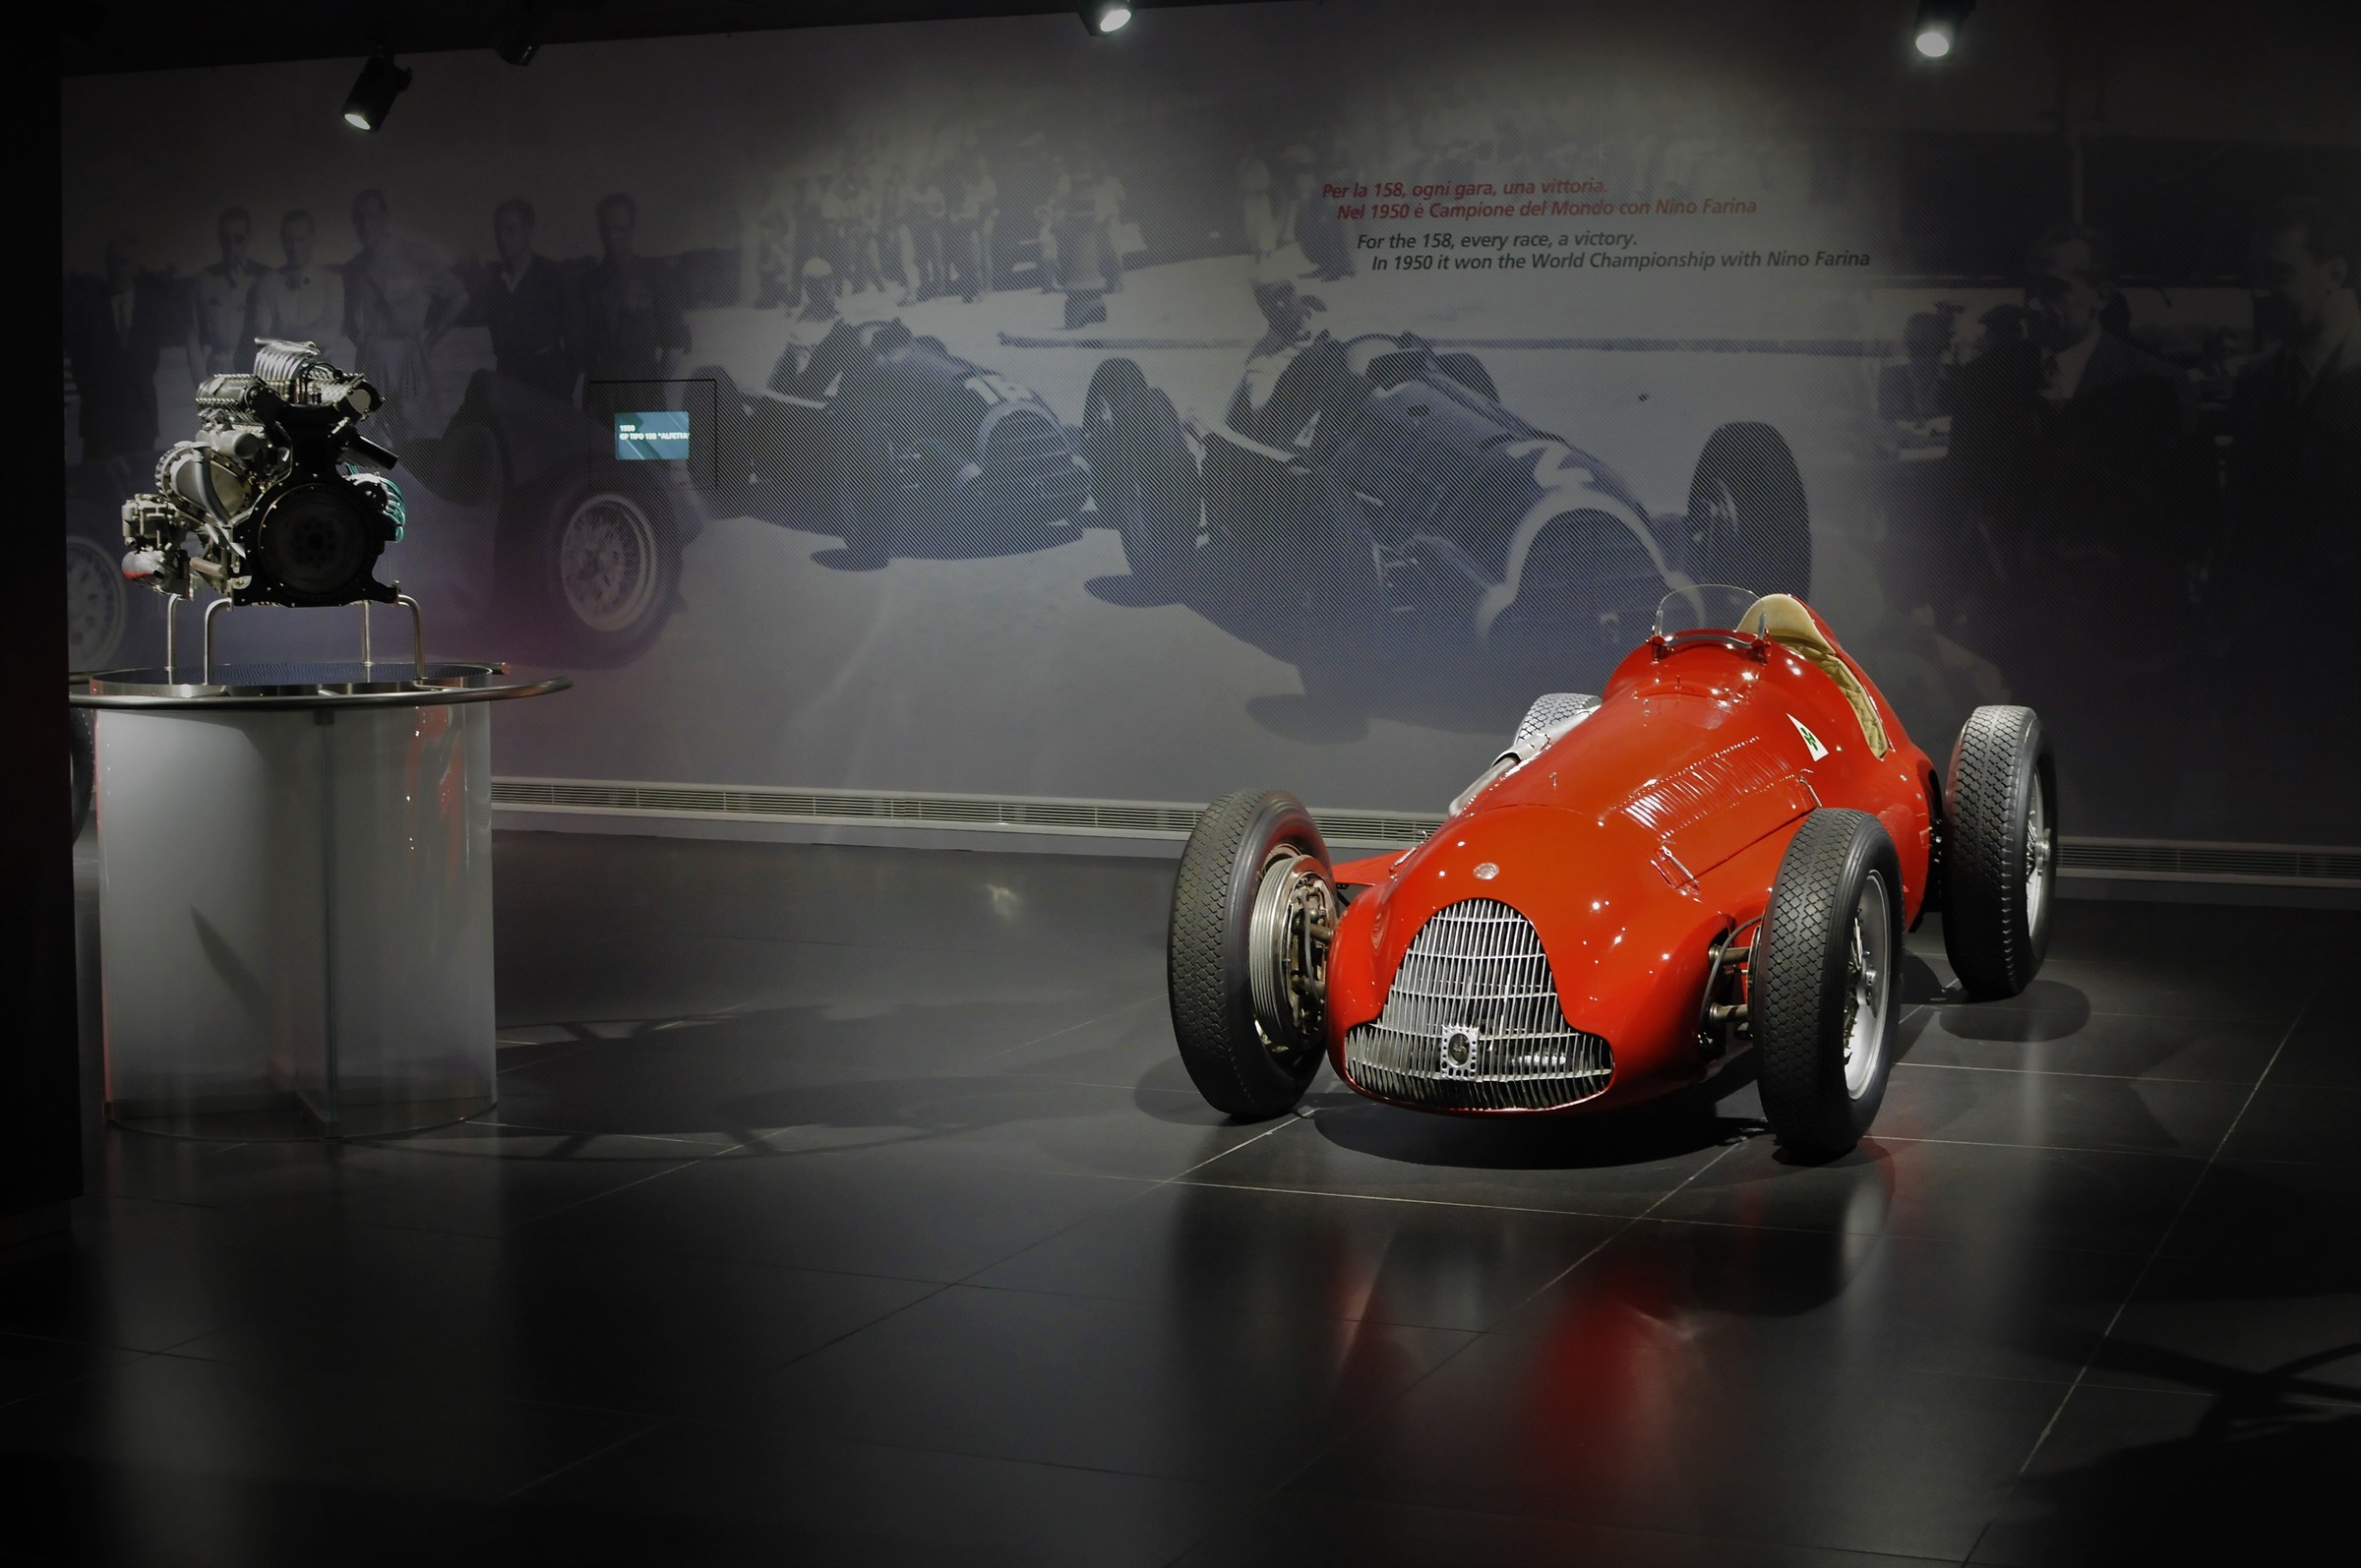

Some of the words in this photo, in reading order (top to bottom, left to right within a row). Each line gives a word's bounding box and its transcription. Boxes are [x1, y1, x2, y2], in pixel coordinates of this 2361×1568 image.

[1322, 183, 1351, 198] Per
[1353, 181, 1368, 198] la
[1373, 181, 1406, 199] 158,
[1412, 180, 1450, 201] ogni
[1454, 184, 1496, 201] gara,
[1503, 181, 1536, 195] una
[1542, 178, 1607, 195] vittoria.
[1336, 202, 1366, 220] Nel
[1371, 203, 1410, 218] 1950
[1429, 201, 1515, 222] Campione
[1519, 199, 1547, 216] del
[1551, 199, 1614, 216] Mondo
[1618, 201, 1651, 215] con
[1655, 198, 1698, 214] Nino
[1702, 197, 1758, 214] Farina
[1357, 234, 1384, 250] For
[1389, 232, 1417, 249] the
[1423, 232, 1455, 250] 158,
[1460, 235, 1508, 251] every
[1512, 235, 1553, 249] race,
[1557, 235, 1569, 247] a
[1574, 230, 1637, 250] victory.
[1371, 256, 1388, 271] In
[1393, 255, 1433, 271] 1950
[1436, 254, 1451, 270] it
[1455, 256, 1493, 270] won
[1497, 253, 1526, 269] the
[1532, 252, 1586, 269] World
[1589, 251, 1716, 271] Championship
[1721, 250, 1762, 267] with
[1767, 250, 1810, 267] Nino
[1815, 250, 1871, 267] Farina
